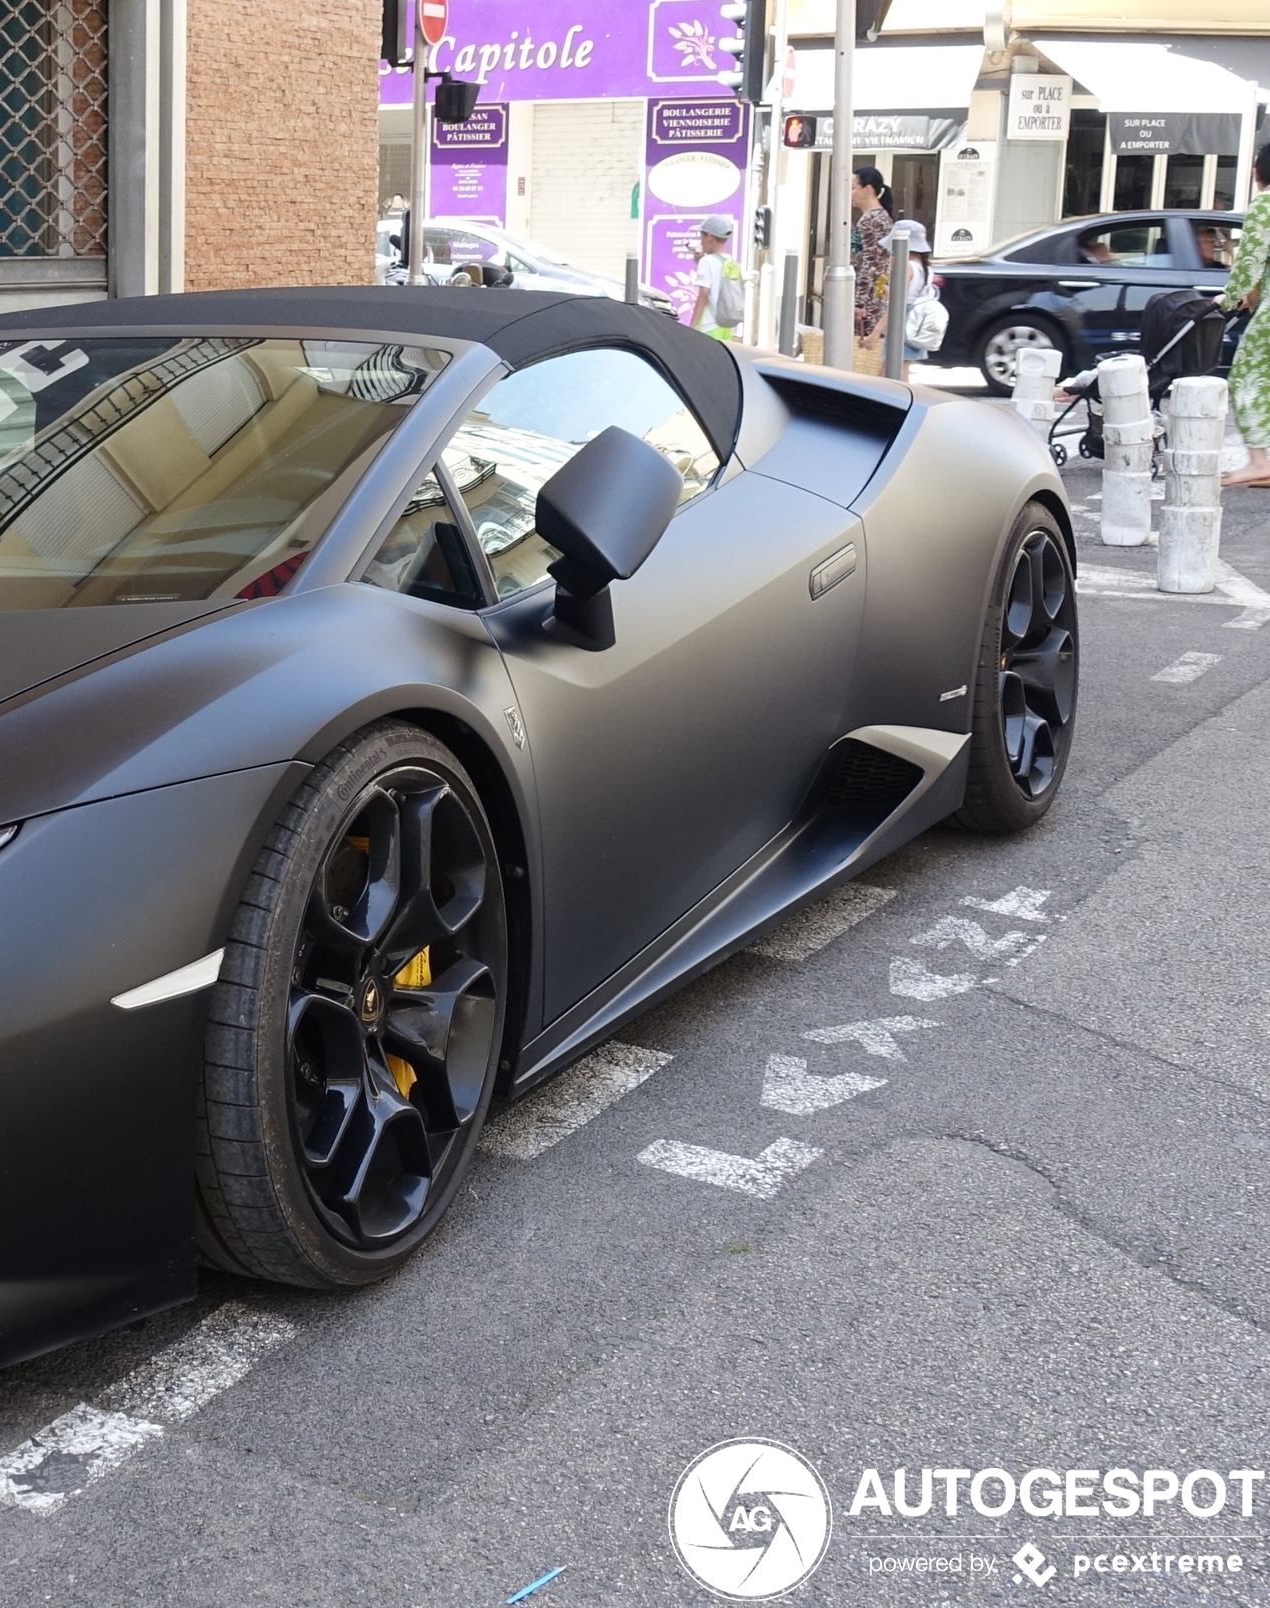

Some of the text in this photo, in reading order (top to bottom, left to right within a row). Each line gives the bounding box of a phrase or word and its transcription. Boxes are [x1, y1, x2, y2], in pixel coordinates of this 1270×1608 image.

[428, 24, 595, 85] Capitole
[1021, 86, 1064, 102] sur PLACE
[662, 108, 732, 117] BOULANGERIE
[1033, 103, 1044, 114] ou
[442, 123, 496, 132] BOULANGER
[662, 118, 731, 127] VIENNOISERIE
[1018, 116, 1063, 131] EMPORTER
[1124, 119, 1166, 128] SUR PLACE
[446, 132, 491, 142] PÂTISSIER
[668, 128, 724, 138] PÂTISSERIE
[1139, 130, 1152, 138] OU
[864, 135, 925, 146] VIETNAMIEN
[1120, 140, 1170, 150] A EMPORTER
